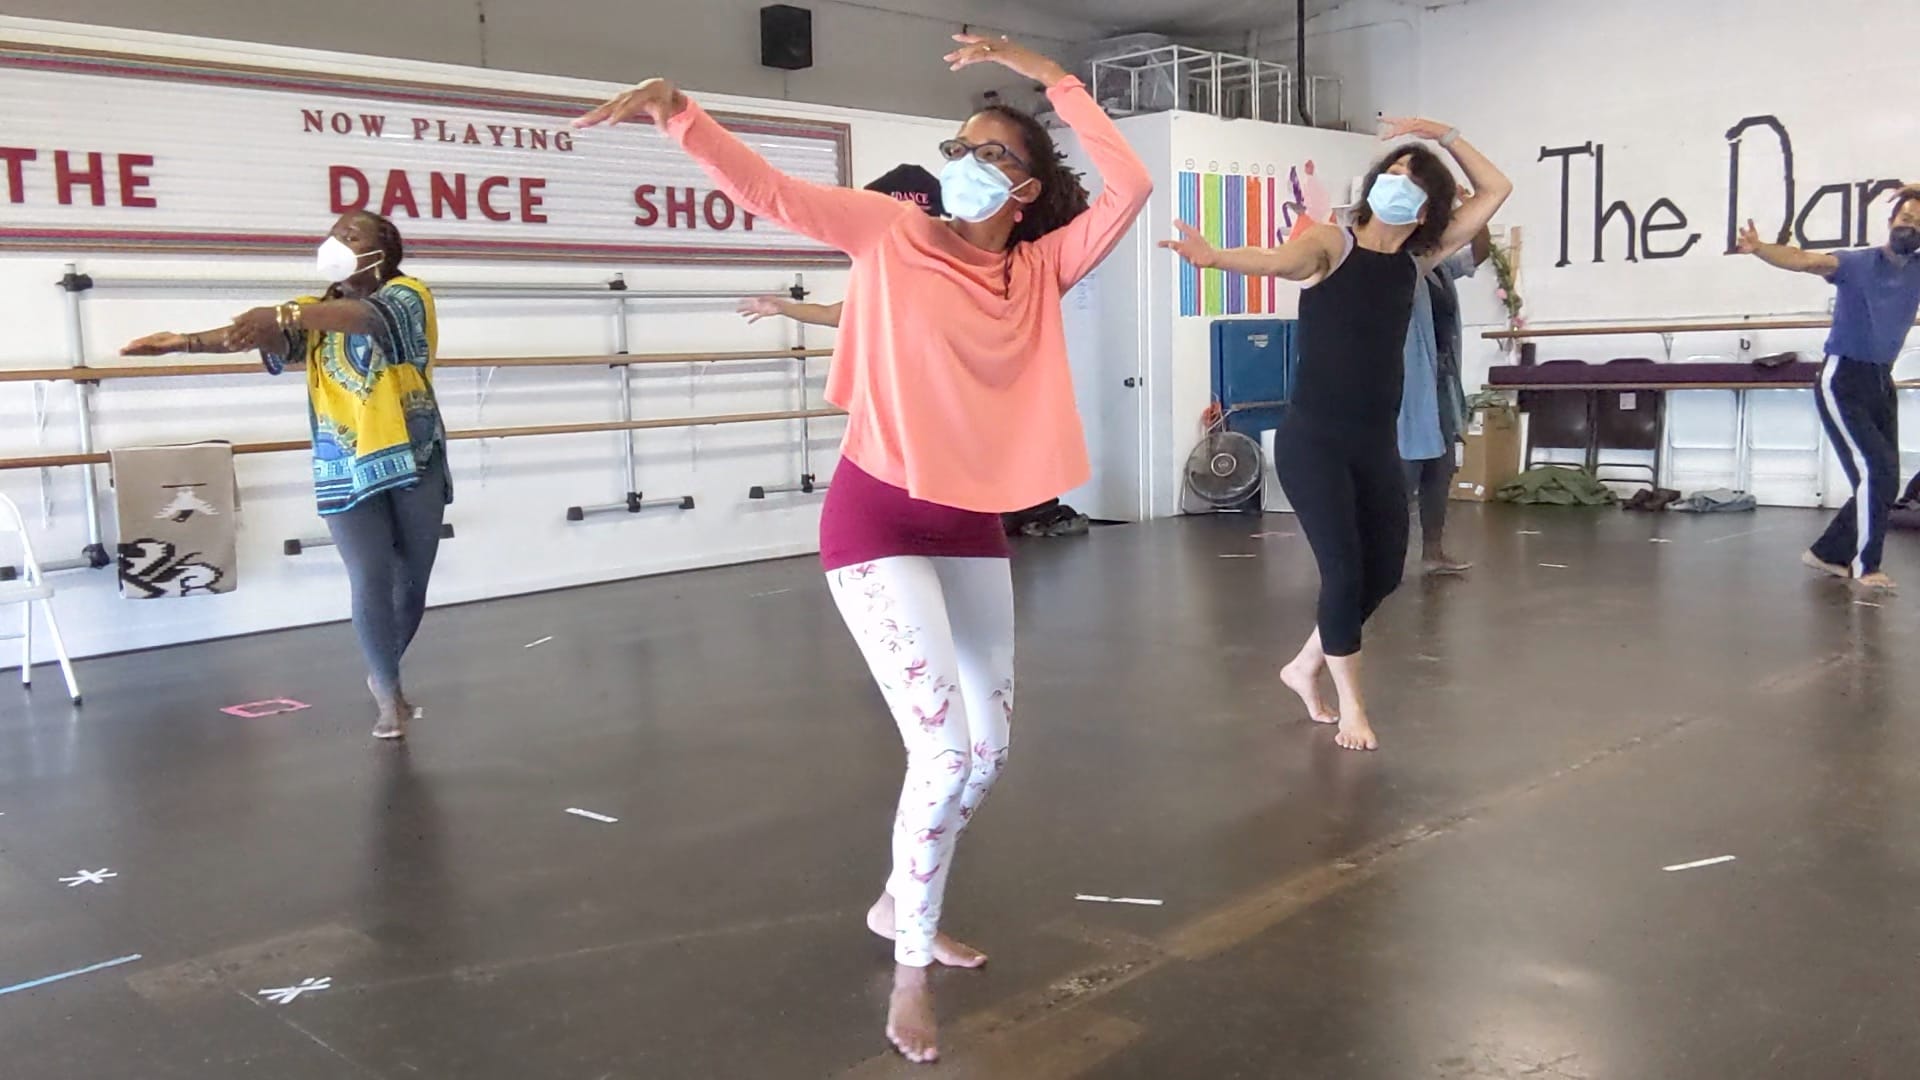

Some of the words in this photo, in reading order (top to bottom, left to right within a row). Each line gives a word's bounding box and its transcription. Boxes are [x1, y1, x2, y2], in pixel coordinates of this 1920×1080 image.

[301, 109, 385, 138] NOW
[411, 117, 574, 152] PLAYING
[0, 146, 157, 208] THE
[328, 165, 549, 224] DANCE
[1537, 141, 1702, 268] The
